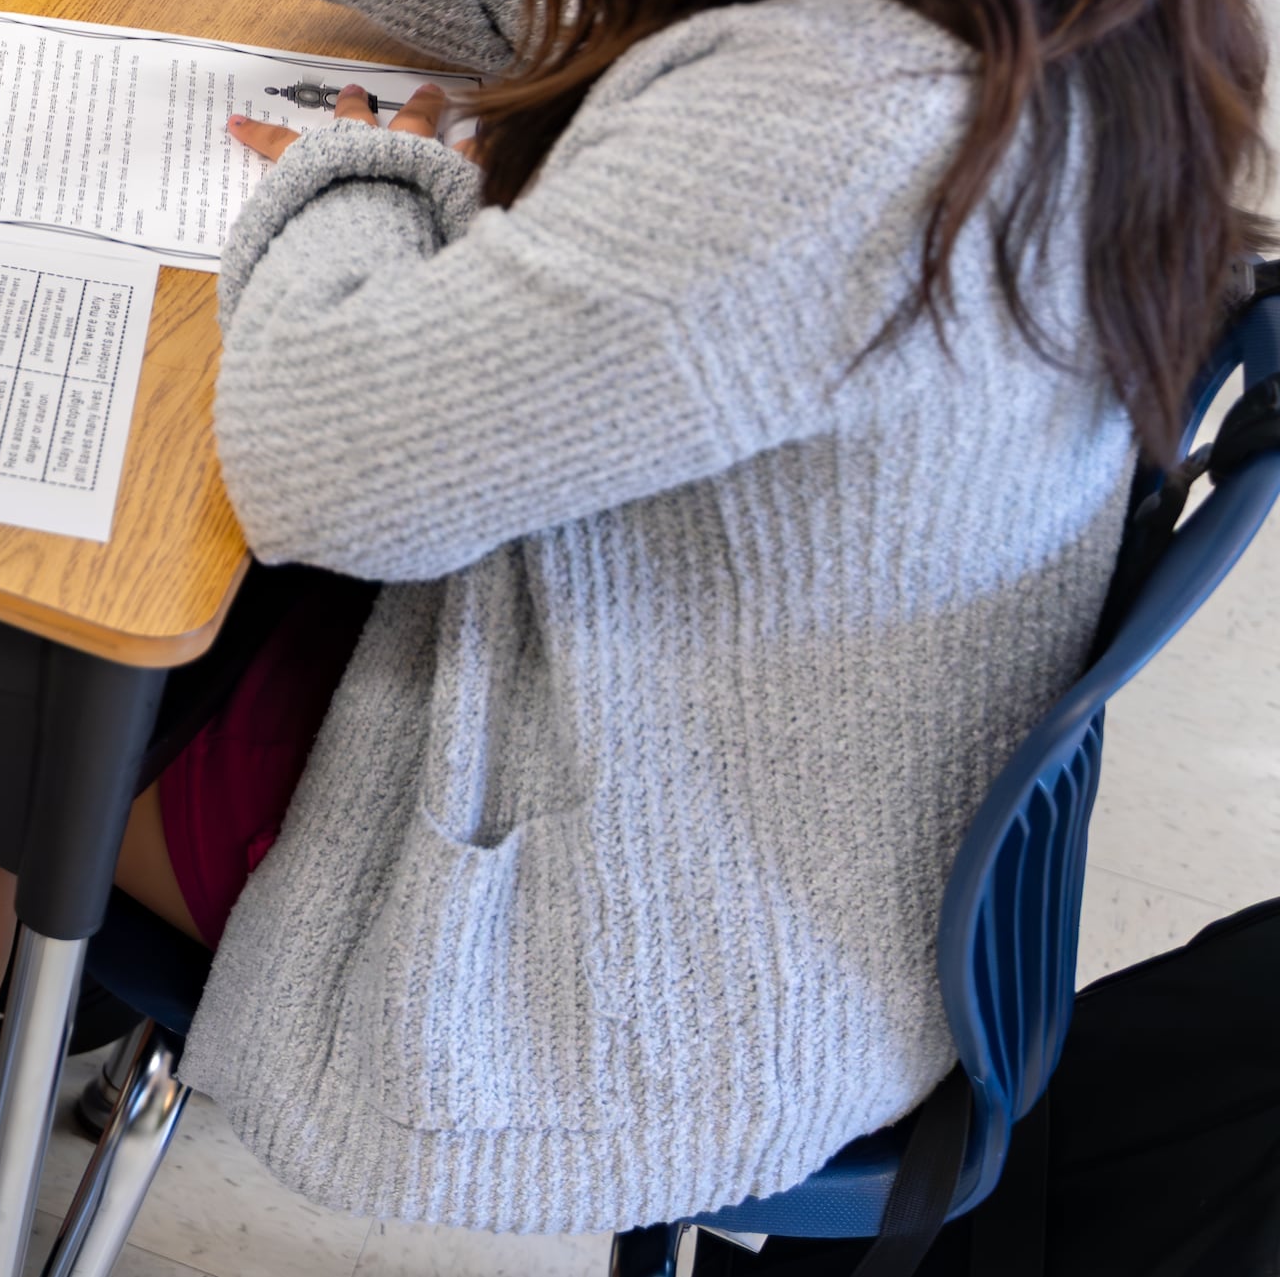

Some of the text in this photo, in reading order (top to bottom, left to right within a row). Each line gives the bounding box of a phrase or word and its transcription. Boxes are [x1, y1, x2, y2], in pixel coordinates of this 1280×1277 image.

[75, 296, 104, 365] There were many
[95, 338, 112, 379] accidents
[104, 320, 116, 337] and
[2, 451, 18, 468] Red
[12, 398, 30, 442] associated
[23, 381, 33, 397] with
[52, 389, 84, 472] Today the stoplight
[83, 413, 100, 436] many
[24, 435, 41, 463] danger
[77, 438, 93, 464] saves
[74, 465, 86, 482] still
